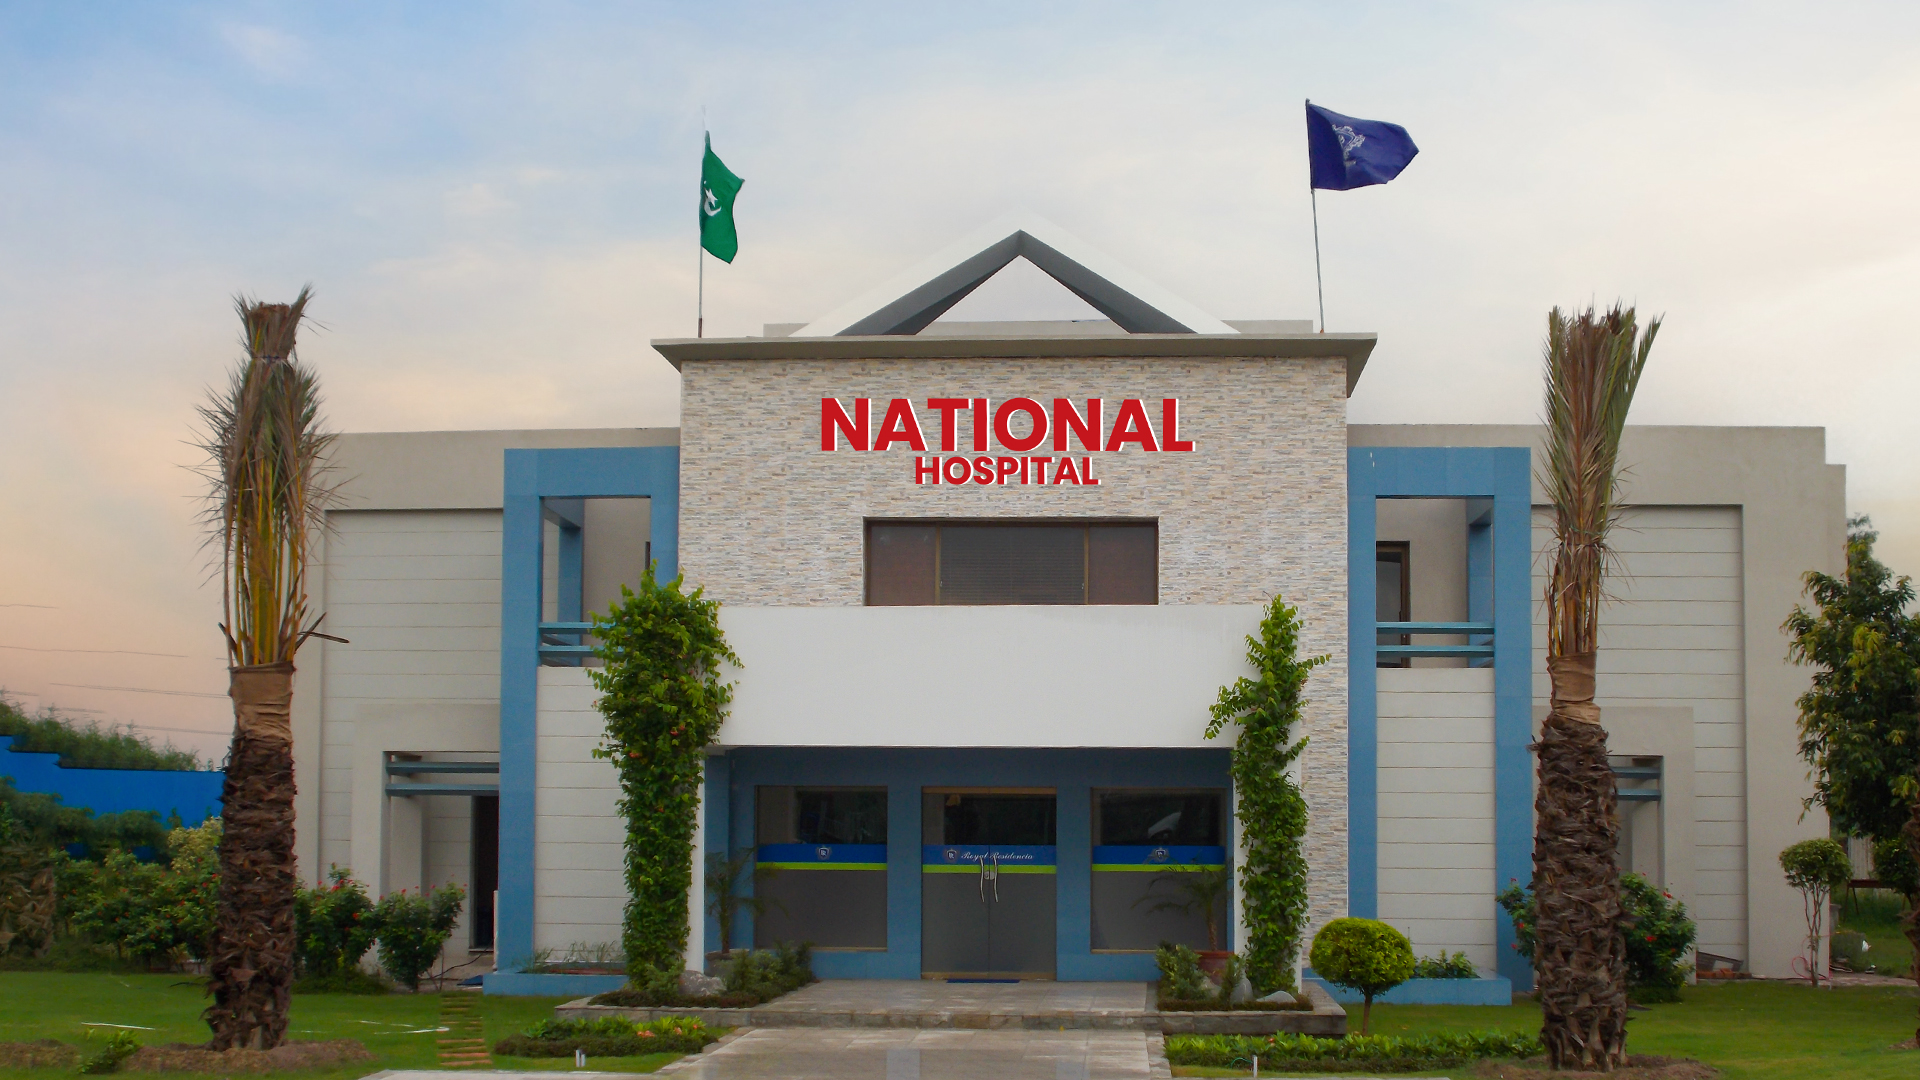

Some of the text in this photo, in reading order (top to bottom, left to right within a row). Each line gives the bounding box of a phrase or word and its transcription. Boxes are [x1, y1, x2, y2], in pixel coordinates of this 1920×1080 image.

[821, 397, 1196, 452] NATIONAL
[915, 456, 1101, 486] HOSPITAL
[961, 851, 988, 862] Royal
